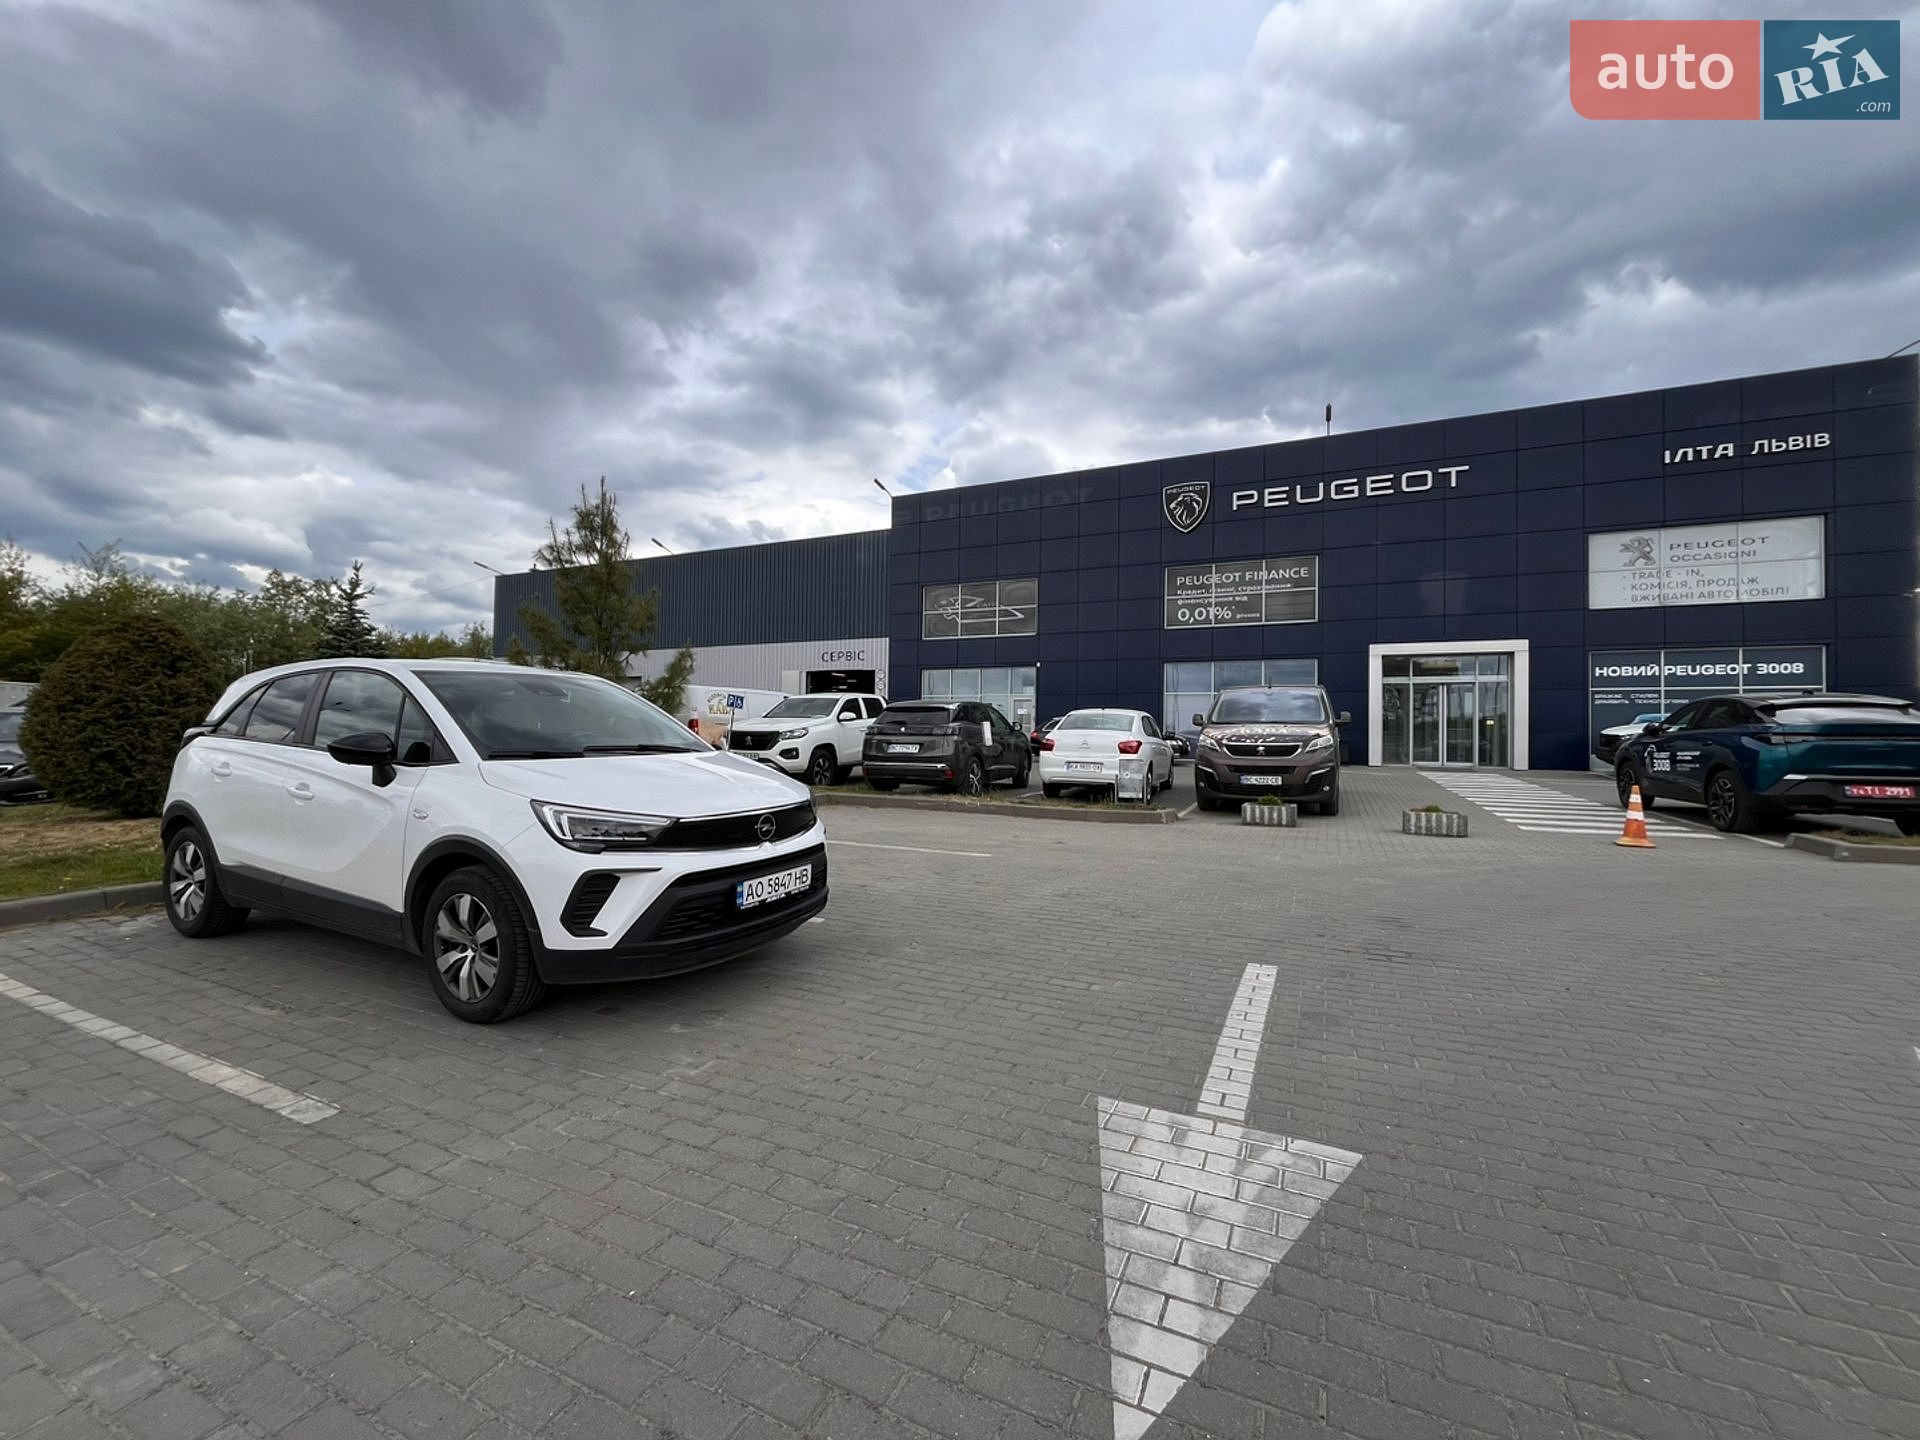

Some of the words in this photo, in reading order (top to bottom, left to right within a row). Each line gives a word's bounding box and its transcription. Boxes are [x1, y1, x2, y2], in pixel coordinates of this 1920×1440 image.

[1663, 443, 1735, 464] ІЛТА
[1751, 433, 1831, 455] ЛЬВІВ
[1166, 484, 1207, 495] PEUGEOT
[1231, 465, 1470, 511] PEUGEOT
[1669, 536, 1771, 551] PEUGEOT
[1176, 572, 1242, 586] PEUGEOT
[1245, 566, 1309, 581] FINANCE
[821, 650, 865, 662] СЕРВІС
[1594, 663, 1660, 677] НОВИЙ
[1664, 663, 1752, 676] PEUGEOT
[1756, 662, 1805, 675] 3008
[1653, 759, 1671, 771] 3008
[745, 881, 764, 902] AO
[767, 872, 792, 895] 5847
[794, 868, 809, 887] HB
